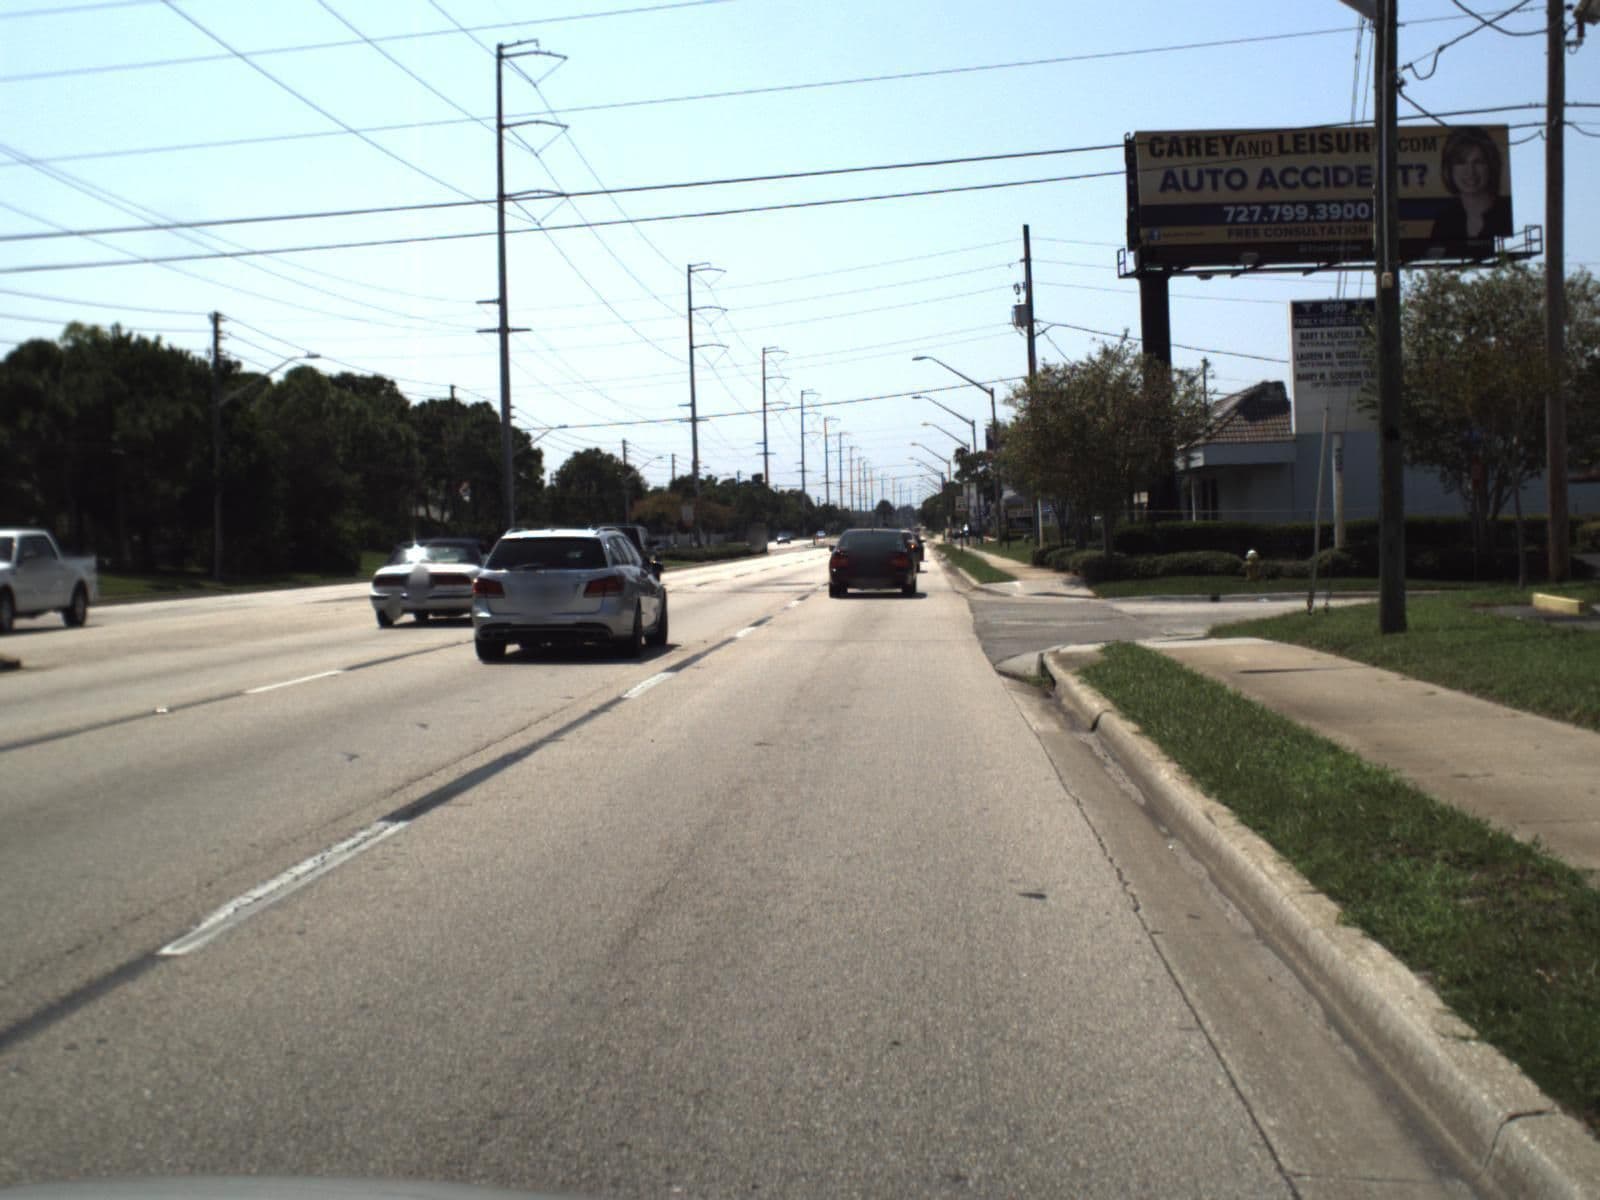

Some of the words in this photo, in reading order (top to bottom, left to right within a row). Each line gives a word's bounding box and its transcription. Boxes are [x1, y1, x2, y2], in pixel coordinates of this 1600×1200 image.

[1277, 131, 1376, 155] LEISUR
[1159, 167, 1248, 193] AUTO
[1256, 163, 1428, 191] ACCIDET?
[1223, 202, 1370, 223] 727.799.3900
[1226, 226, 1261, 239] FREE
[1263, 223, 1368, 238] CONSULTATION
